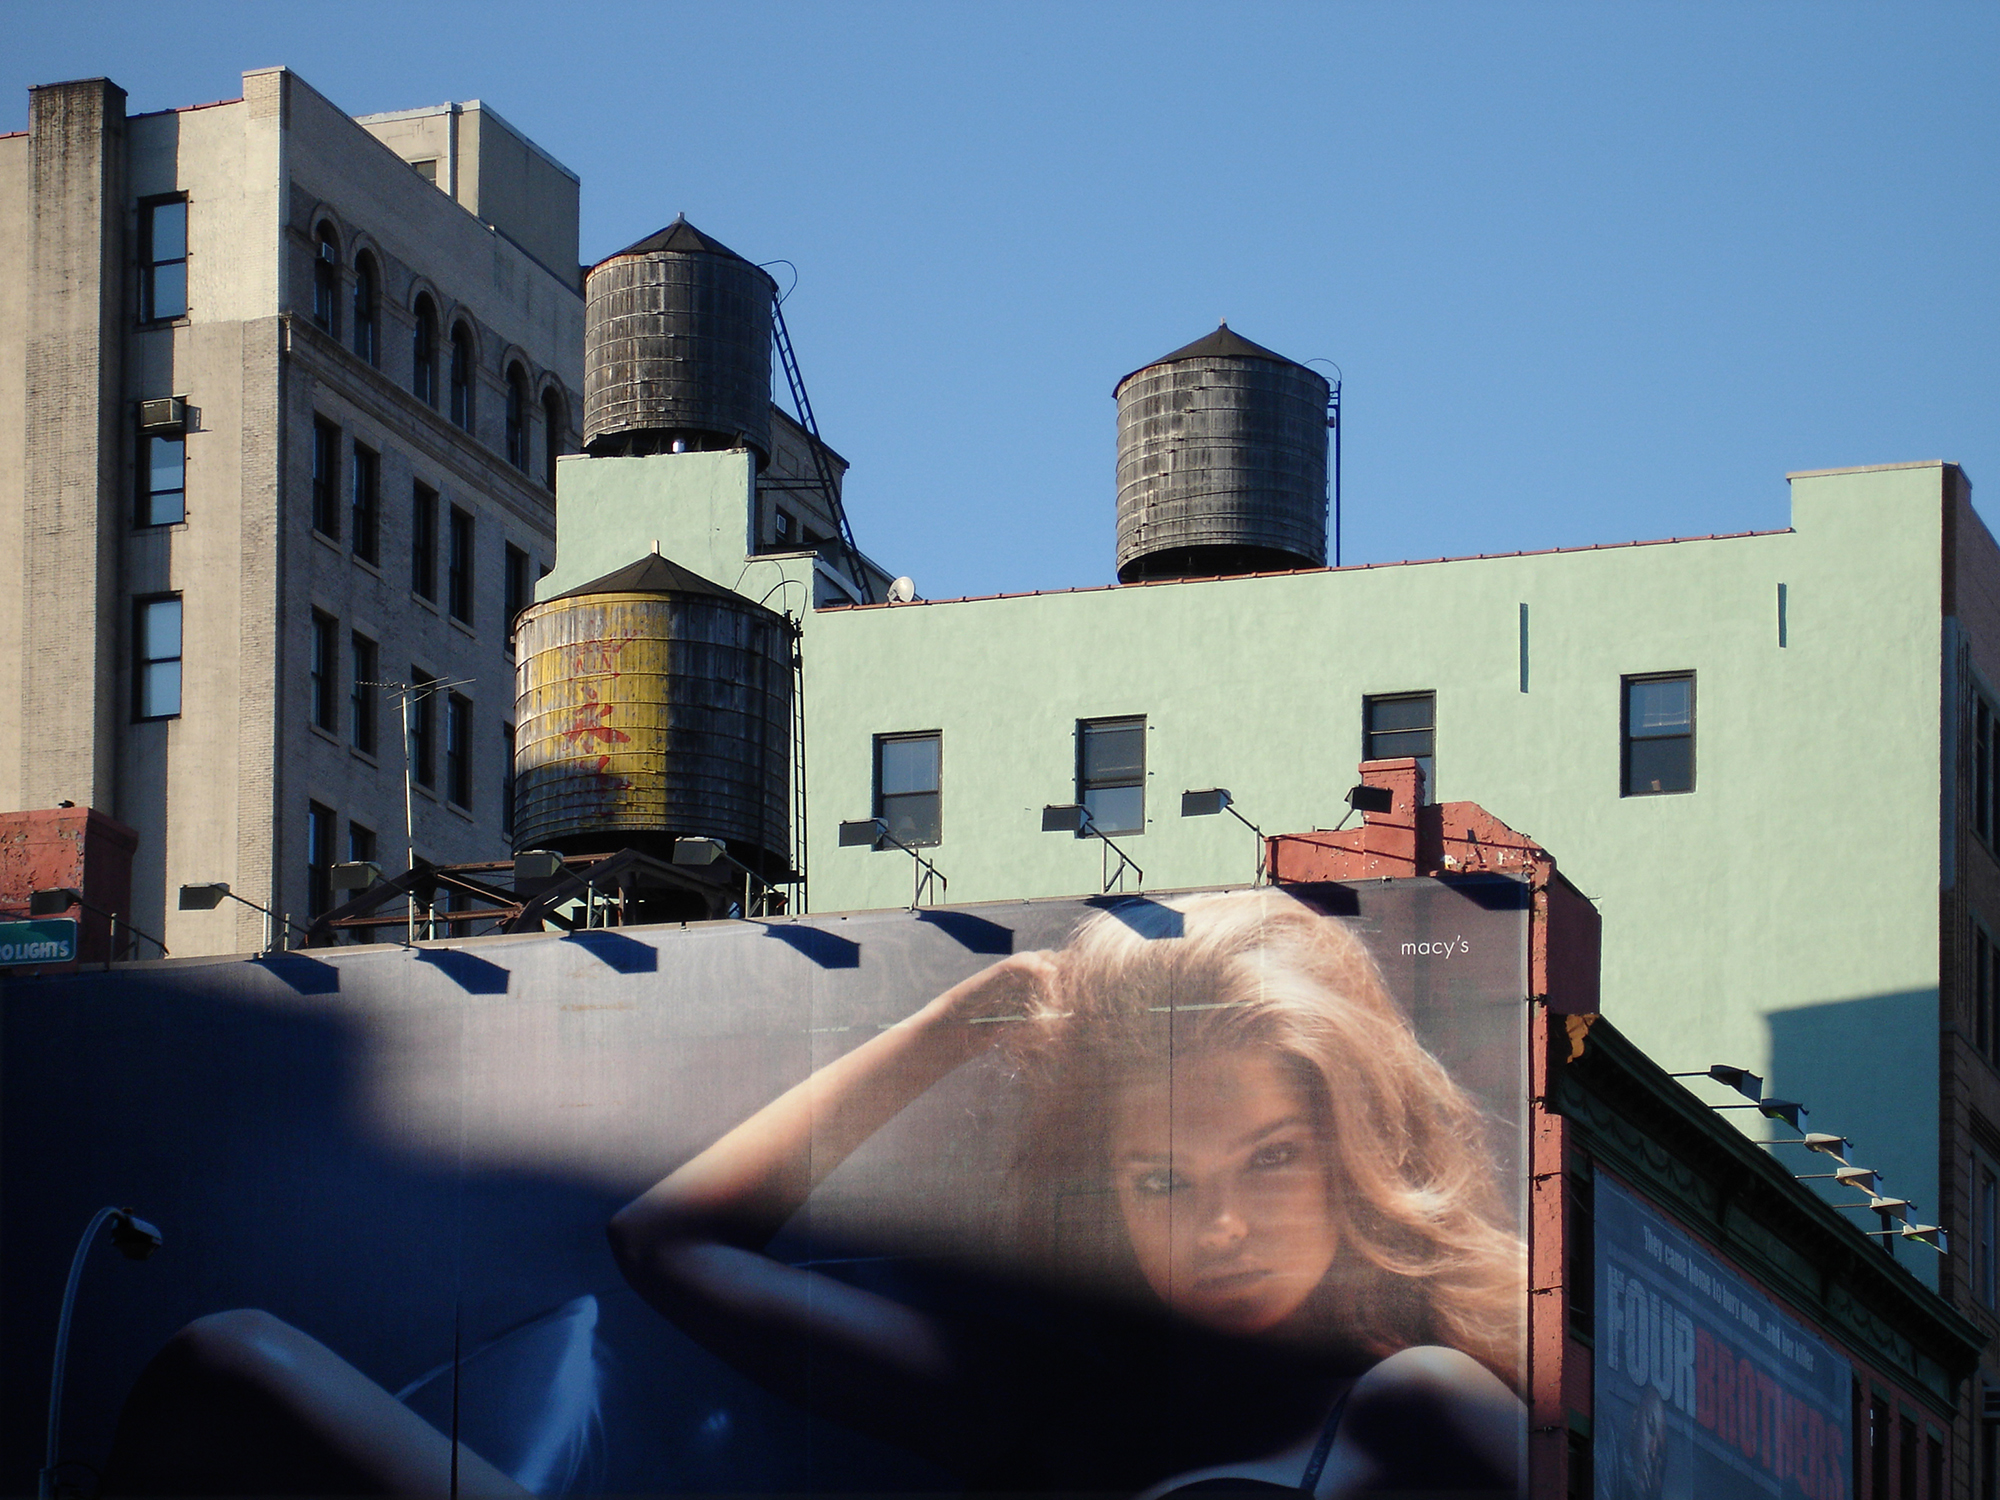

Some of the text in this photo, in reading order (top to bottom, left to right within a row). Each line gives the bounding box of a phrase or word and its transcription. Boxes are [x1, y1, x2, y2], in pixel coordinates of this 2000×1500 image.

[15, 940, 70, 960] LIGHTS
[1401, 934, 1469, 960] macy's
[1643, 1225, 1663, 1263] They
[1665, 1244, 1687, 1278] came
[1607, 1263, 1845, 1500] FOUR BROTHERS
